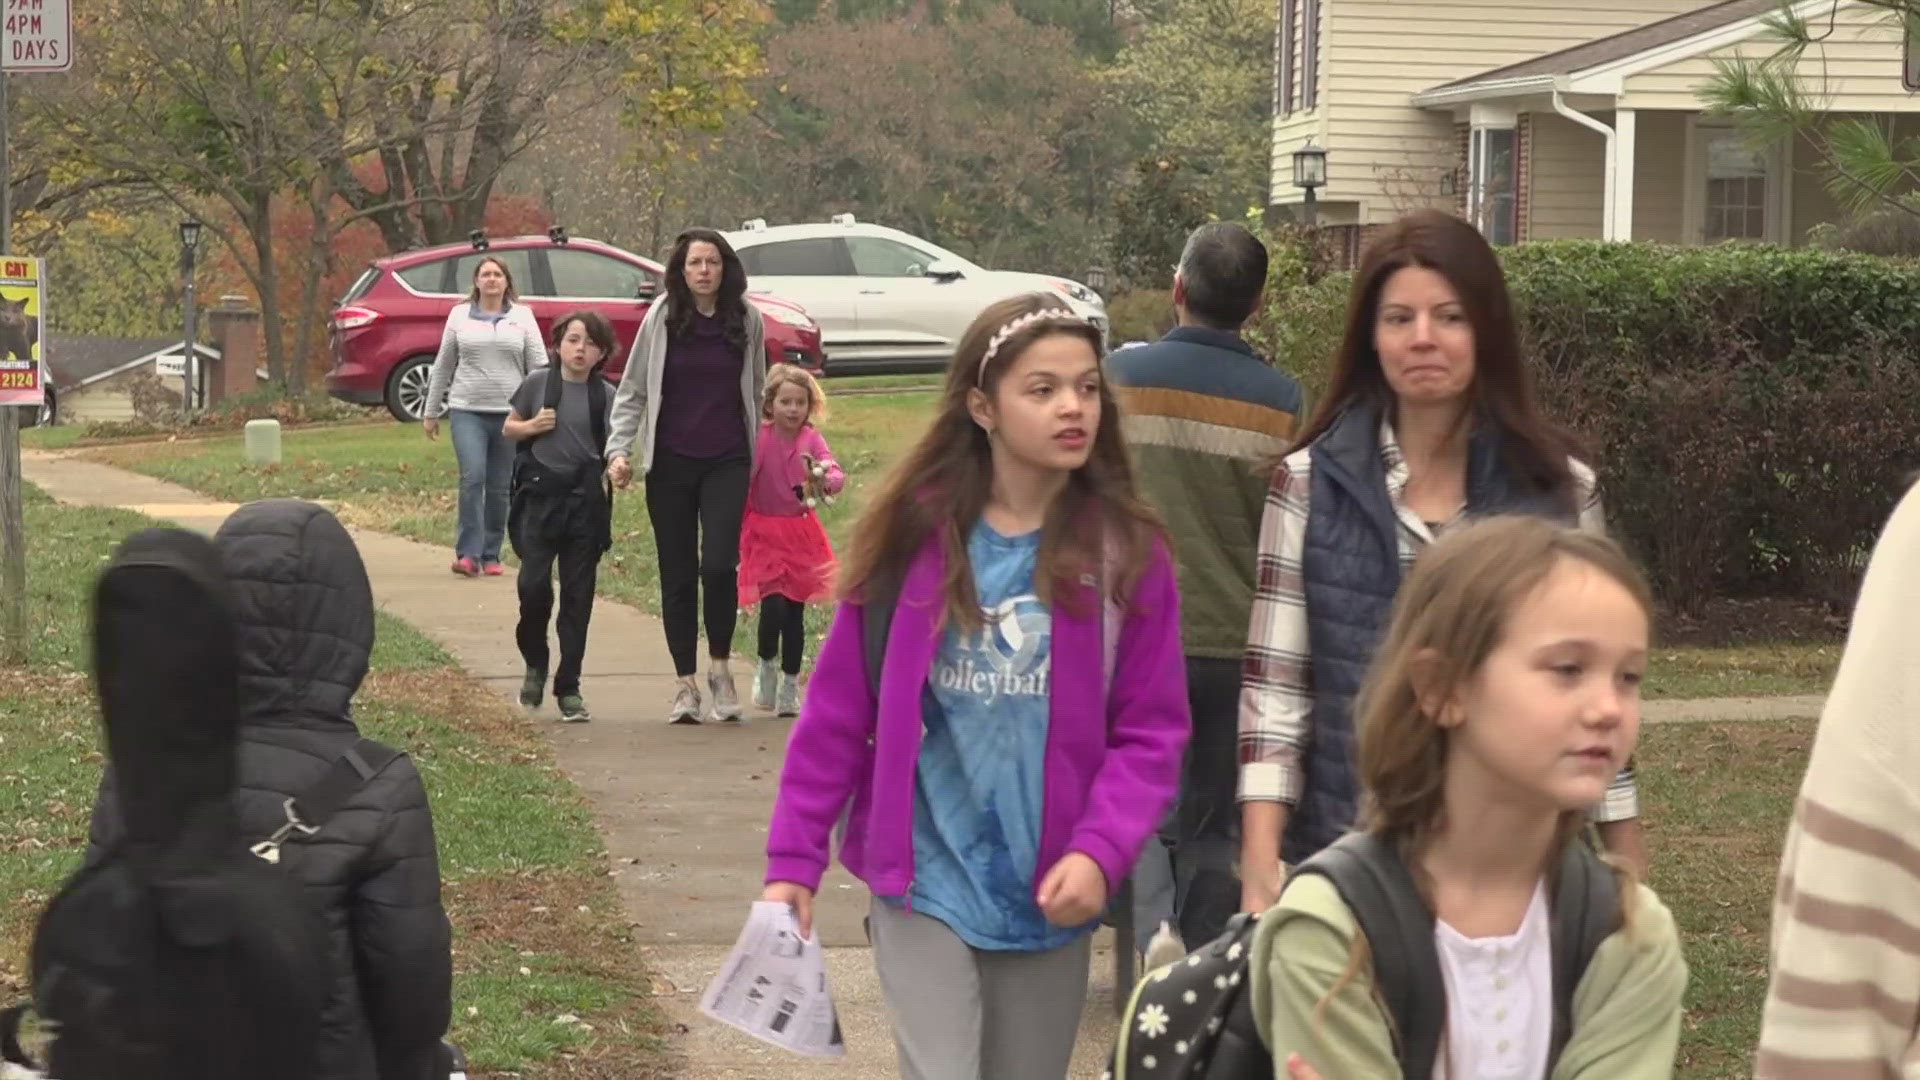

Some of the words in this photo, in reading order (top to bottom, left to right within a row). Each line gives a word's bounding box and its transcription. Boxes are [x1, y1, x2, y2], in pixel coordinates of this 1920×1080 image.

[6, 14, 41, 35] 4PM
[13, 39, 58, 60] DAYS
[5, 261, 28, 277] CAT
[2, 372, 33, 388] 2124
